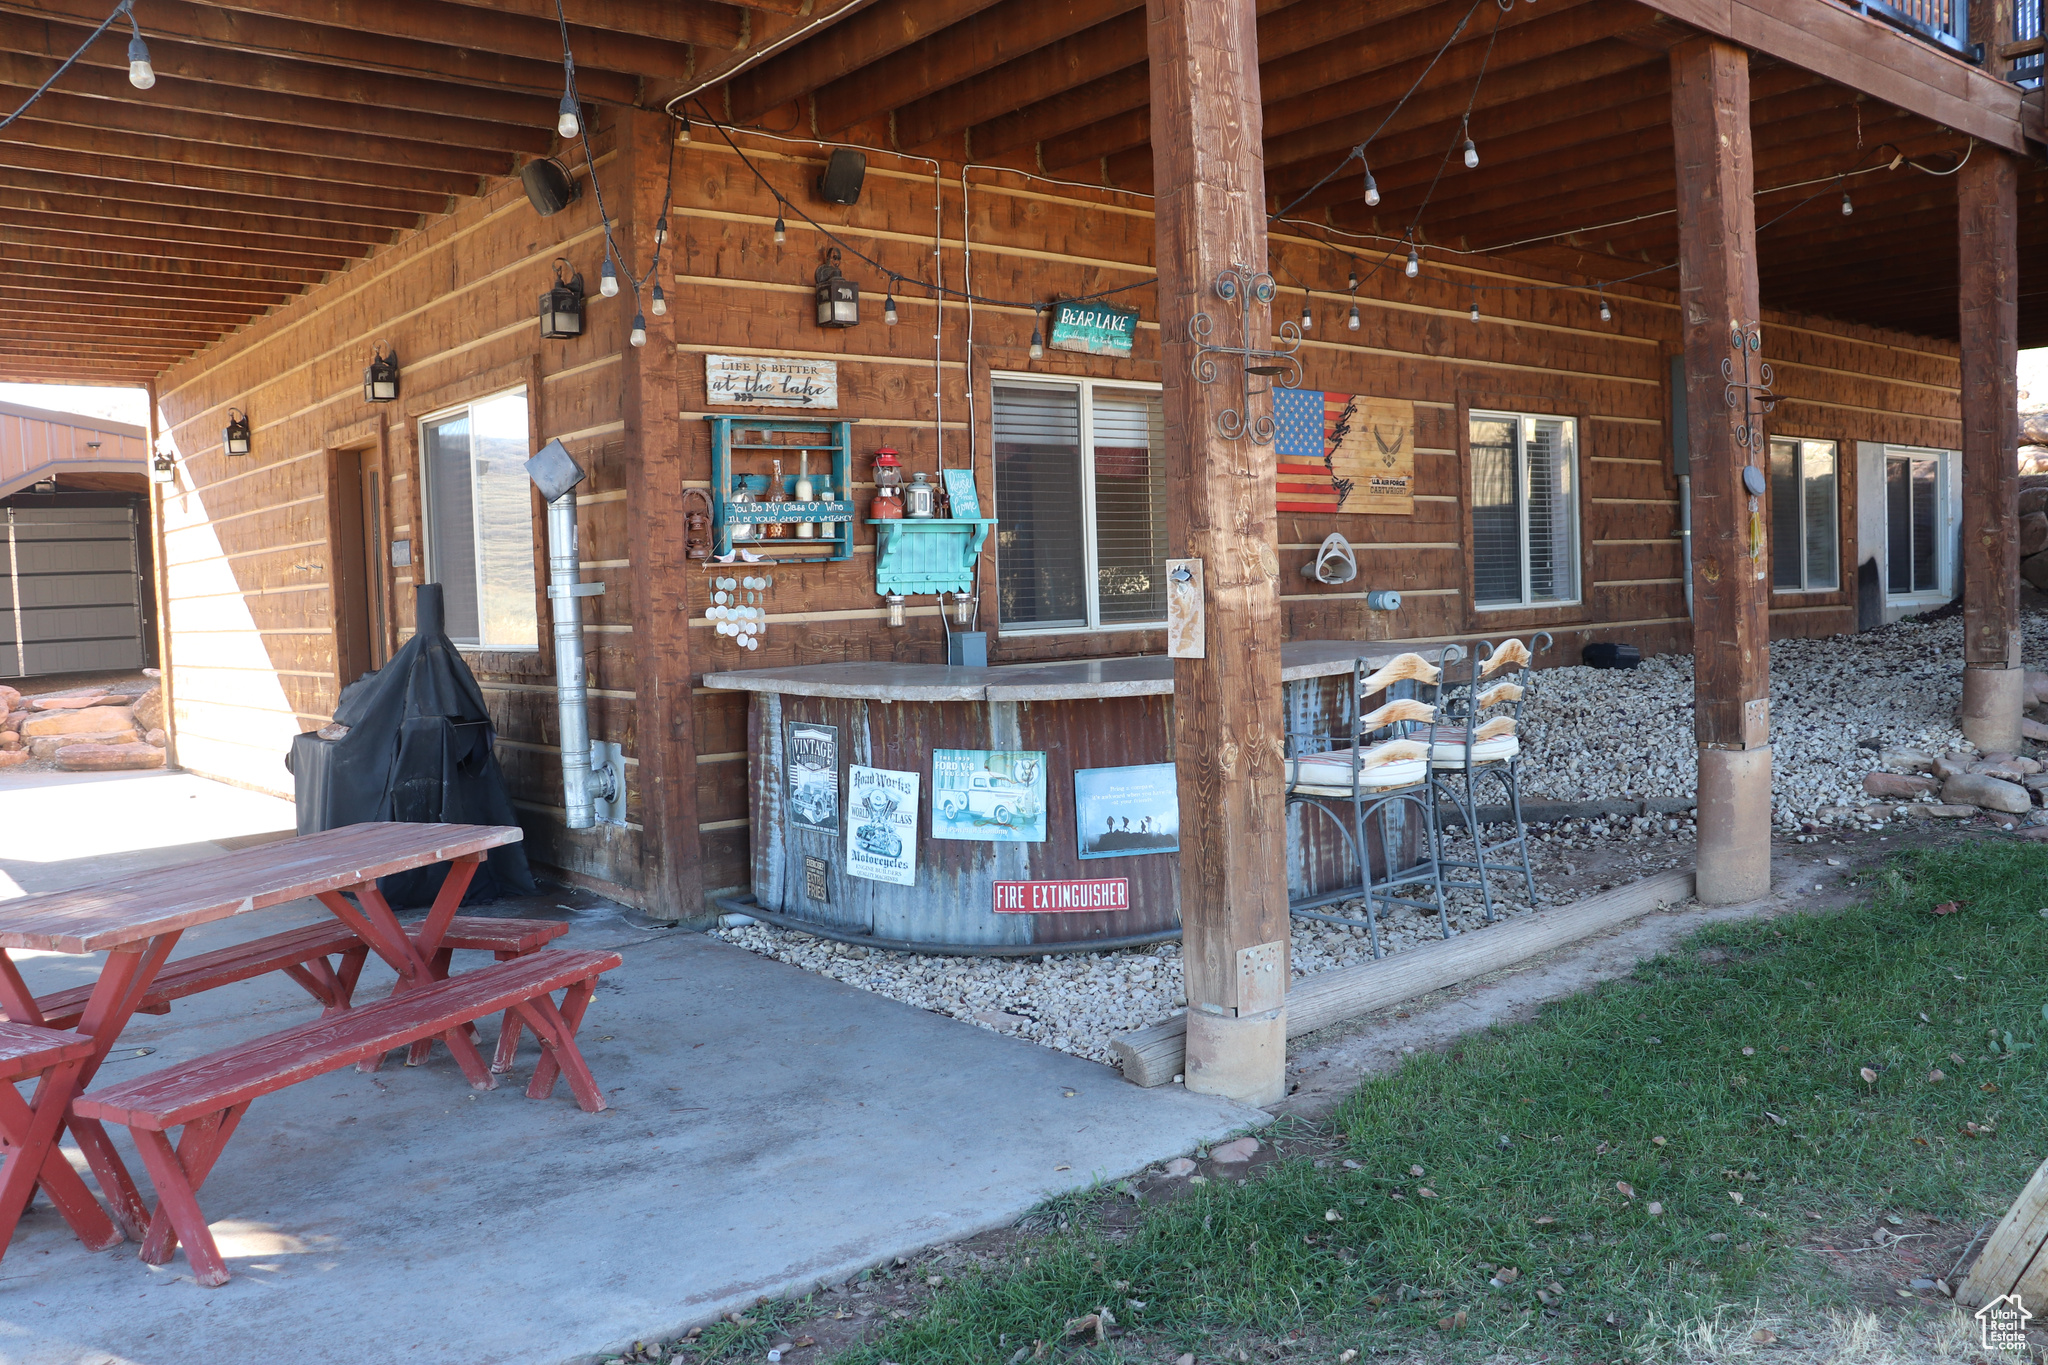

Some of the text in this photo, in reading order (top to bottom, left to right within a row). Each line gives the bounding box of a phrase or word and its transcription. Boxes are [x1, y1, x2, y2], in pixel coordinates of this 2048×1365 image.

[1060, 308, 1129, 331] BEAR LAKE
[721, 362, 819, 374] LIFE IS BETTER
[712, 371, 830, 396] at the lake
[949, 471, 972, 493] house
[1370, 486, 1407, 494] CARTWRIGHT
[732, 502, 844, 516] You Be My Glass Of Wine
[953, 497, 977, 516] home
[755, 515, 777, 523] YOUR
[779, 515, 802, 523] SHOT
[805, 515, 816, 523] OF
[794, 739, 833, 758] VINTAGE
[935, 761, 975, 771] FORD V-8
[854, 770, 911, 794] Road Works
[851, 806, 913, 825] WORLD CLASS
[979, 827, 1008, 836] Economy
[851, 849, 909, 869] Motorcycles
[856, 864, 874, 872] ENGINE
[807, 871, 824, 886] EXTRA
[807, 882, 824, 900] FRIES
[997, 882, 1125, 909] FIRE EXTINGUISHER
